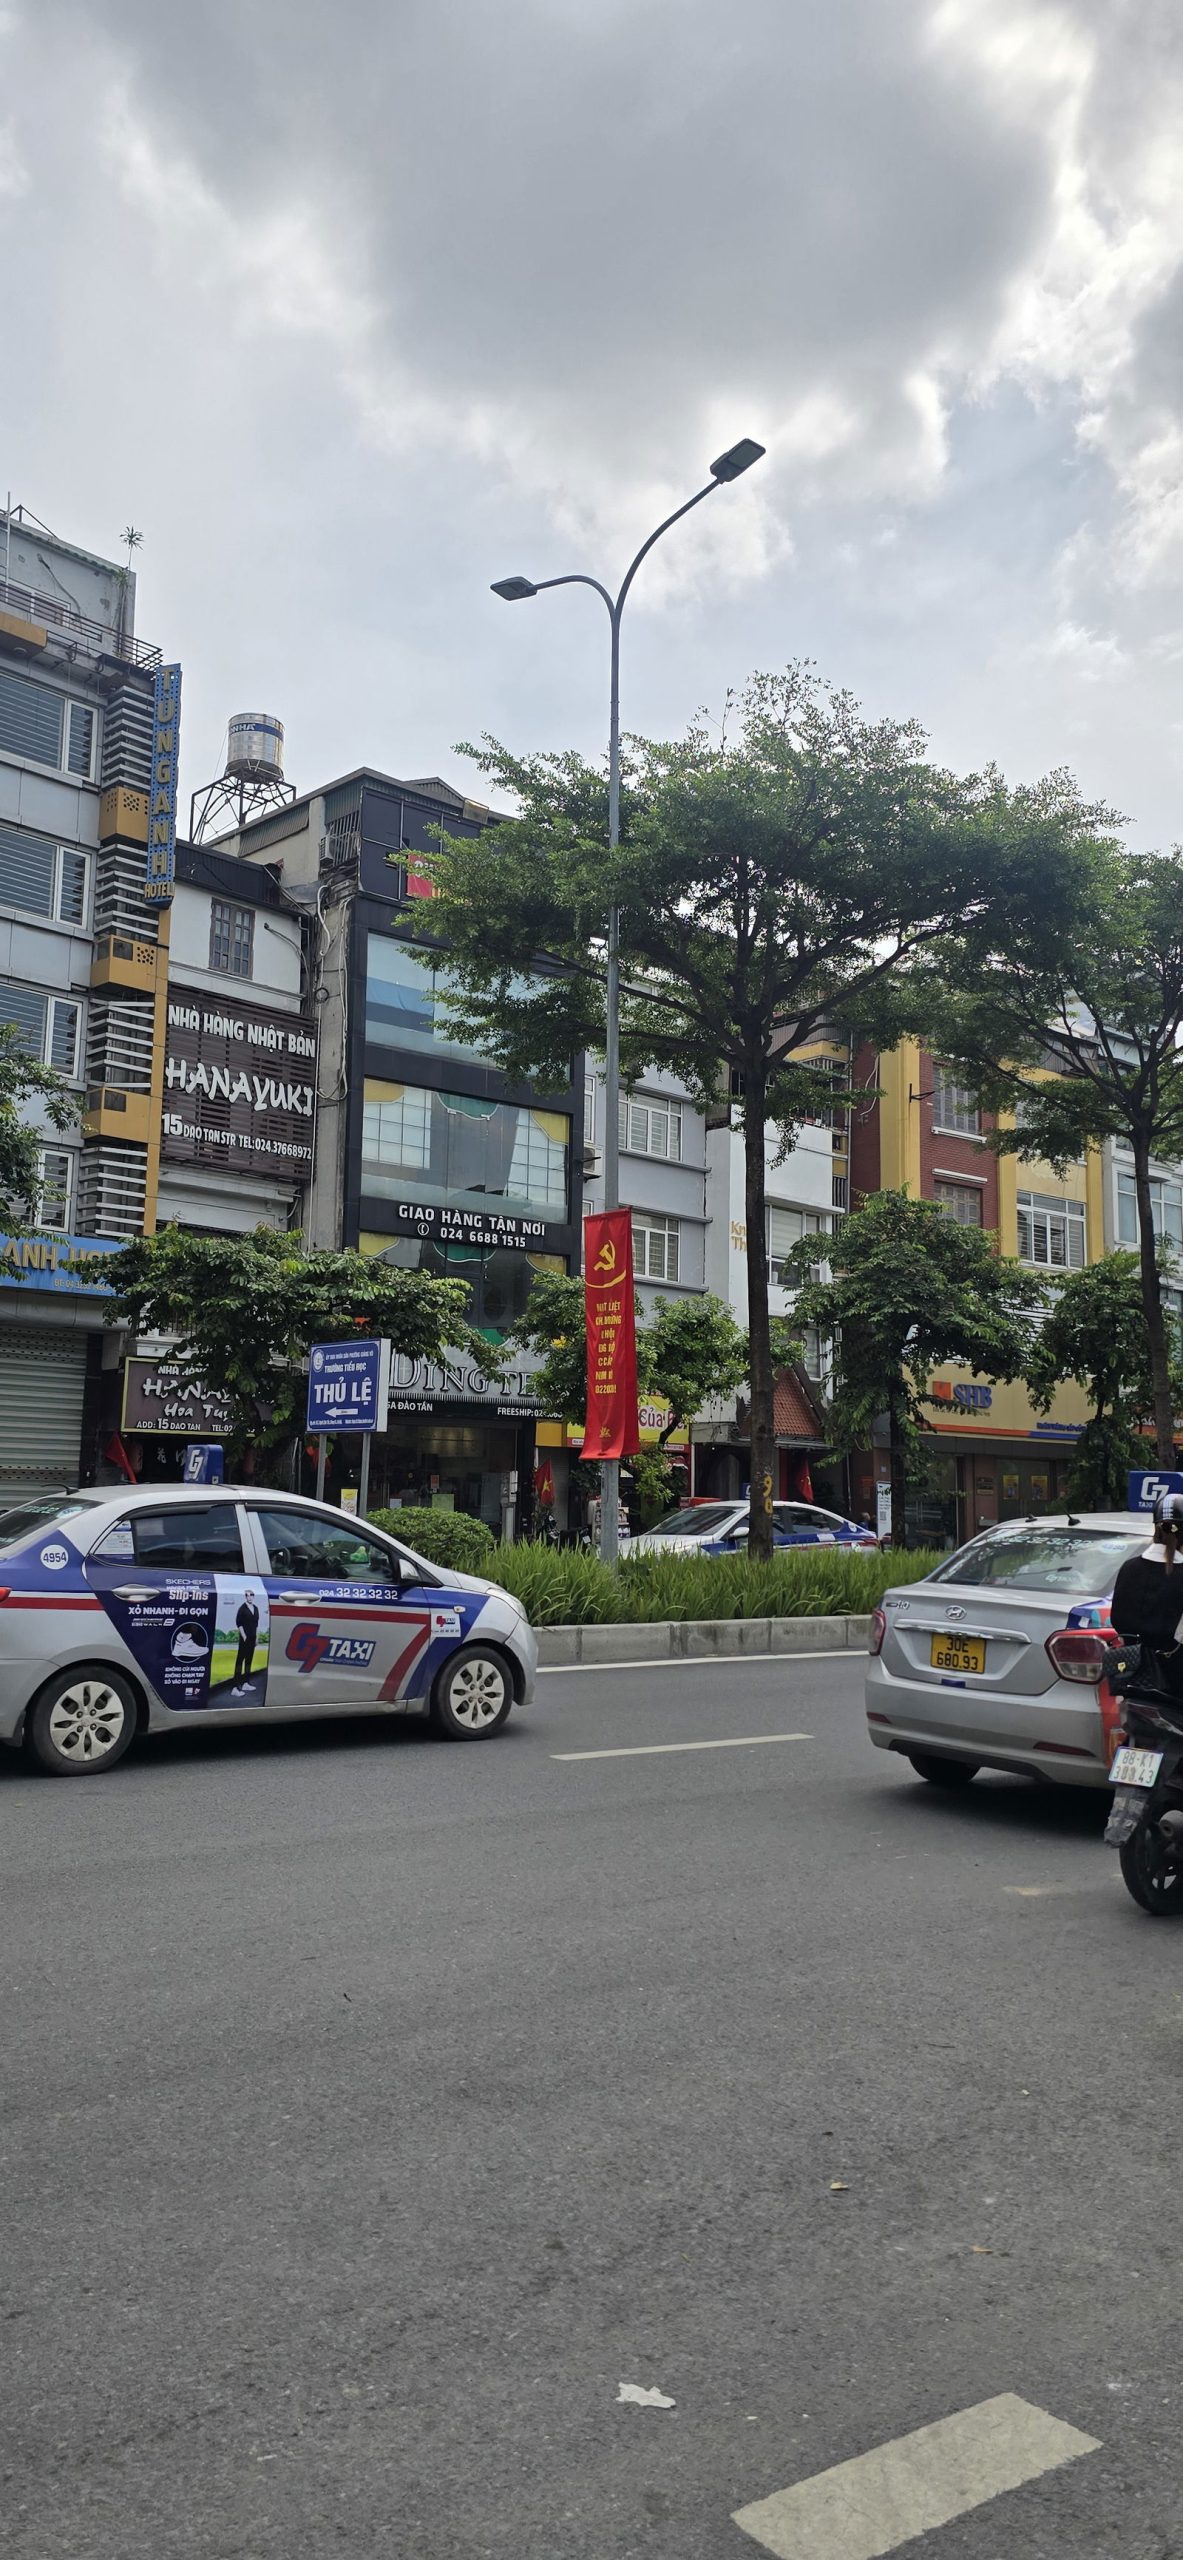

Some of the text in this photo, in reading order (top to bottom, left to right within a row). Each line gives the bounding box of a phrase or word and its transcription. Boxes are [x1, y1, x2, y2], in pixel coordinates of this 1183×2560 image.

[144, 882, 172, 898] HOTEL
[168, 1005, 316, 1058] NHÀ HÀNG NHẬT BẢN
[165, 1057, 314, 1117] HANAYUKI
[162, 1113, 183, 1136] 15
[183, 1124, 202, 1140] DAO
[203, 1127, 220, 1144] TAN
[221, 1131, 236, 1146] STR
[398, 1204, 545, 1237] GIAO HÀNG TẬN NƠI
[440, 1227, 526, 1248] 024 6688 1515
[4, 1238, 57, 1270] ANH
[157, 1363, 179, 1376] NHÀ
[314, 1376, 373, 1406] THỦ LỆ
[498, 1370, 538, 1396] TE
[397, 1400, 416, 1411] ĐÀO
[953, 1384, 992, 1409] SHB
[164, 1402, 194, 1418] Hoa
[136, 1420, 156, 1429] ADD:
[157, 1418, 169, 1430] 15
[170, 1422, 186, 1431] DAO
[187, 1423, 201, 1431] TAN
[188, 1449, 204, 1479] G7
[1140, 1477, 1170, 1503] G7
[43, 1551, 67, 1563] 4954
[165, 1578, 211, 1586] SKECHERS
[352, 1588, 367, 1599] 32
[368, 1589, 382, 1600] 32
[384, 1590, 398, 1600] 32
[128, 1604, 141, 1615] XỎ
[189, 1607, 209, 1617] GỌN
[285, 1622, 374, 1673] G7 TAXI
[947, 1636, 969, 1653] 30E
[937, 1652, 978, 1670] 680.93
